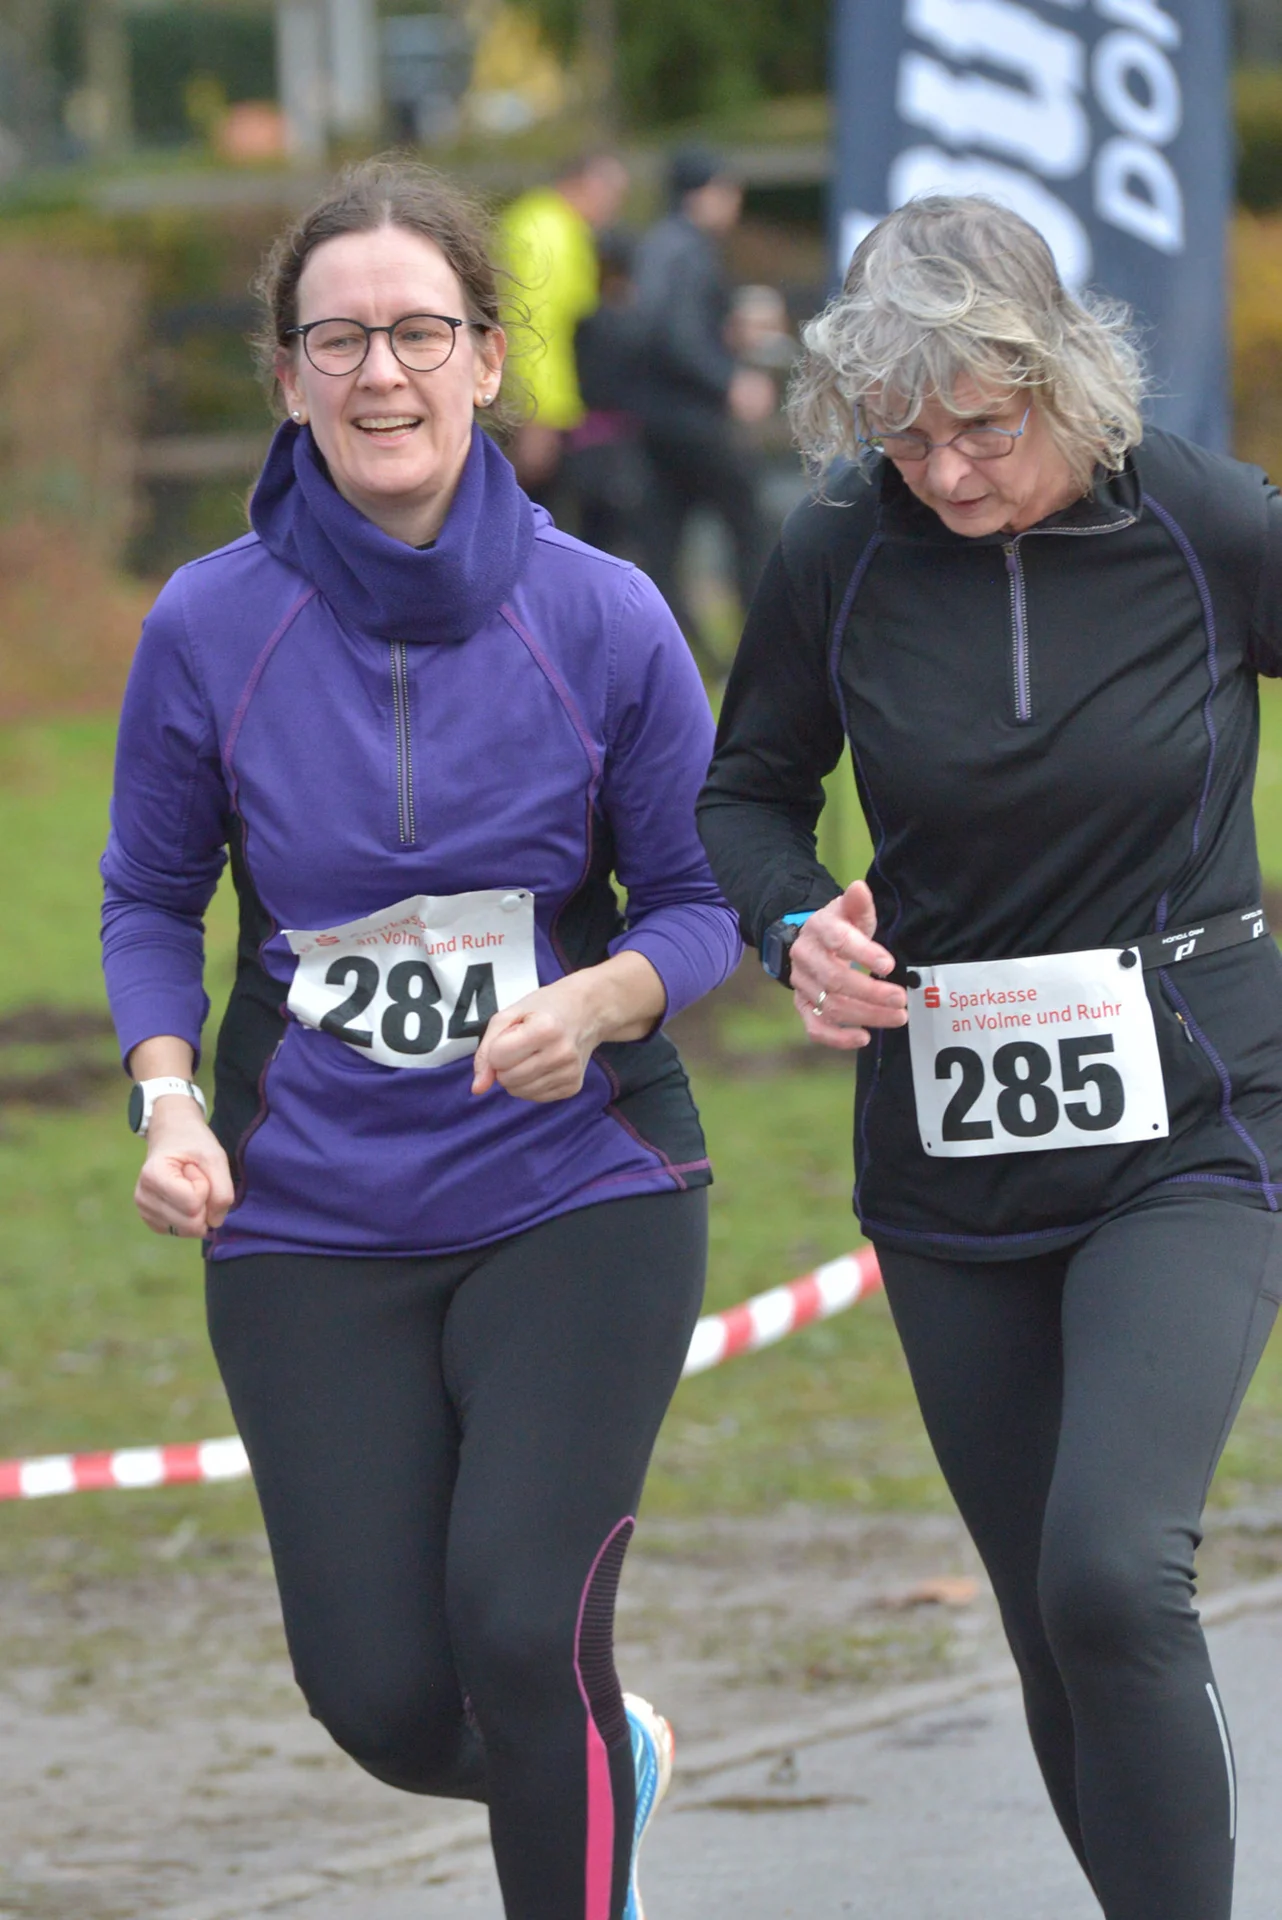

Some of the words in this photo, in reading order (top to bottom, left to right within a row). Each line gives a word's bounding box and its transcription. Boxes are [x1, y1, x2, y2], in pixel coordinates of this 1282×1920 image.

[425, 935, 457, 955] und
[461, 931, 505, 952] Ruhr
[320, 955, 499, 1055] 284
[949, 988, 1037, 1010] Sparkasse
[952, 1017, 972, 1032] an
[975, 1012, 1032, 1030] Volme
[1036, 1008, 1072, 1024] und
[1078, 1001, 1122, 1020] Ruhr
[935, 1034, 1125, 1141] 285
